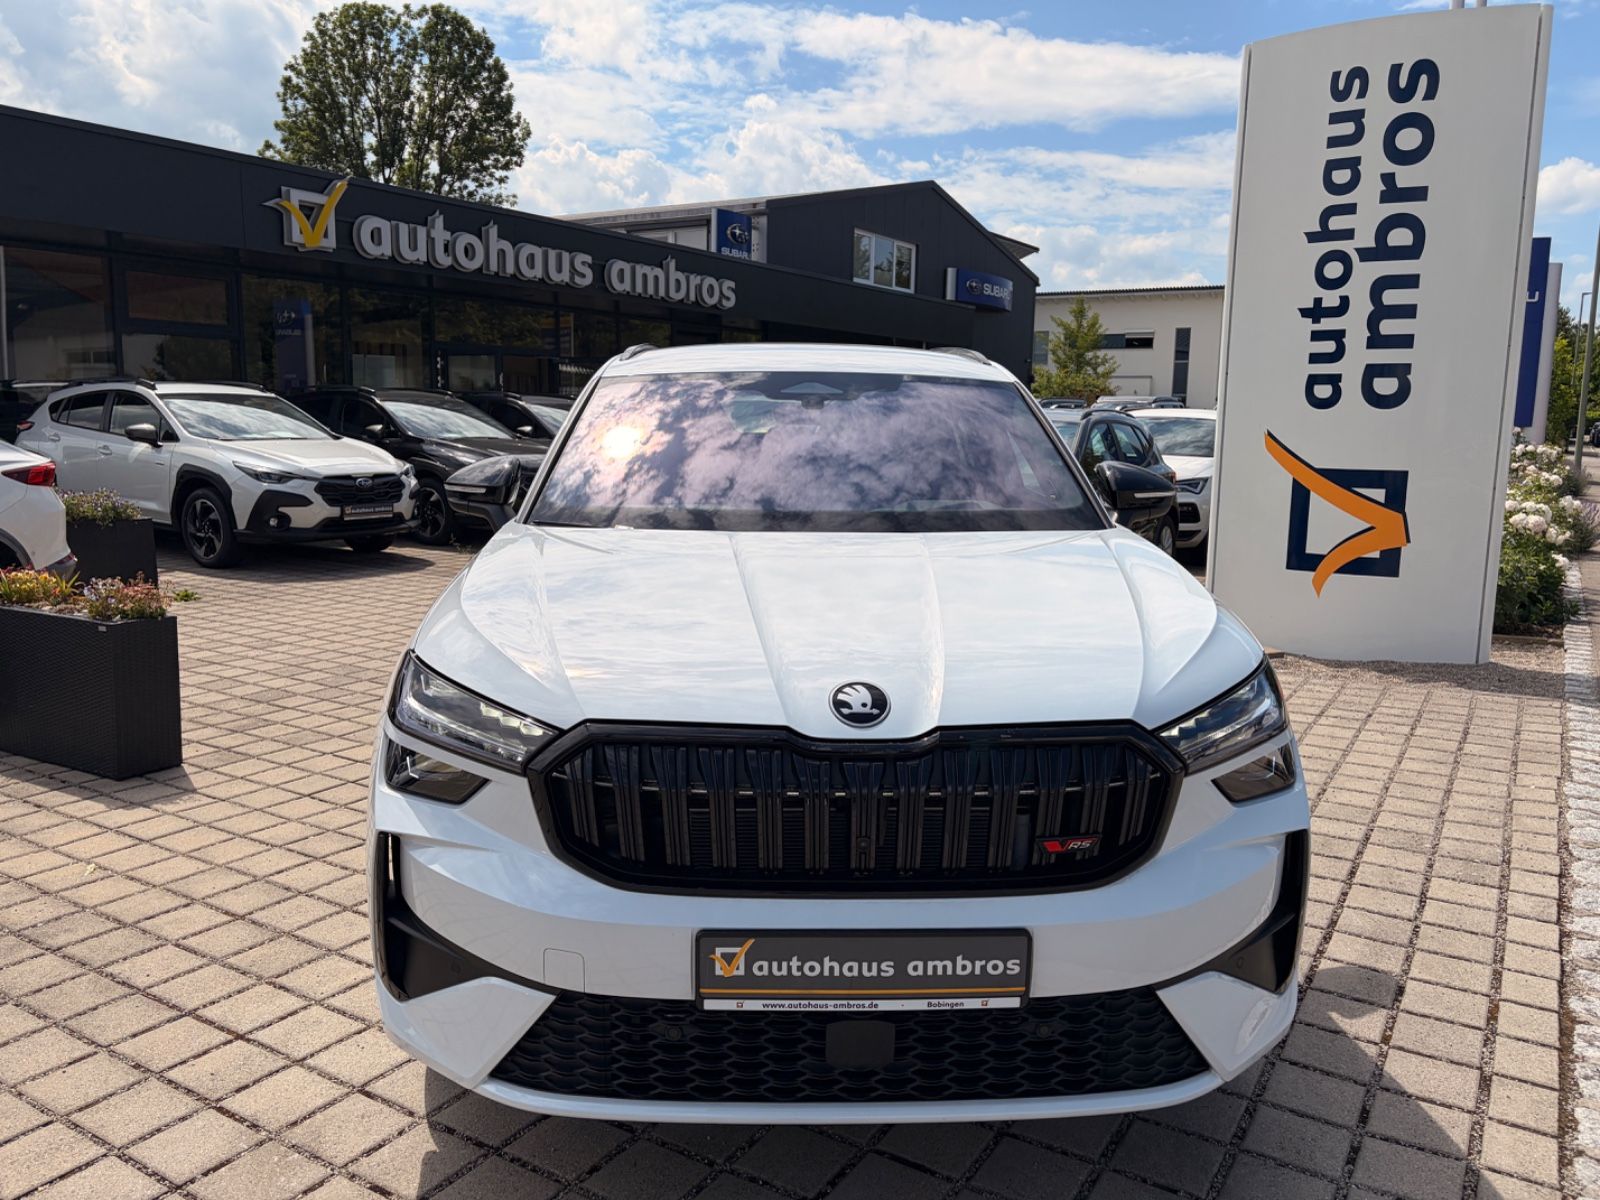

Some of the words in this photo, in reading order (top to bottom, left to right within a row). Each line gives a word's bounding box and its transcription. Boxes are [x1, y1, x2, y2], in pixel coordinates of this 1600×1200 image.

[1297, 65, 1370, 410] autohaus
[1353, 58, 1441, 410] ambros
[353, 209, 594, 288] autohaus
[604, 254, 737, 310] ambros
[720, 246, 750, 260] SUBAR
[983, 283, 1010, 300] SUBAR
[752, 954, 895, 978] autohaus
[906, 954, 1021, 976] ambros
[761, 1001, 879, 1010] www.autohaus-ambros.de
[926, 1001, 965, 1010] Bobingen
